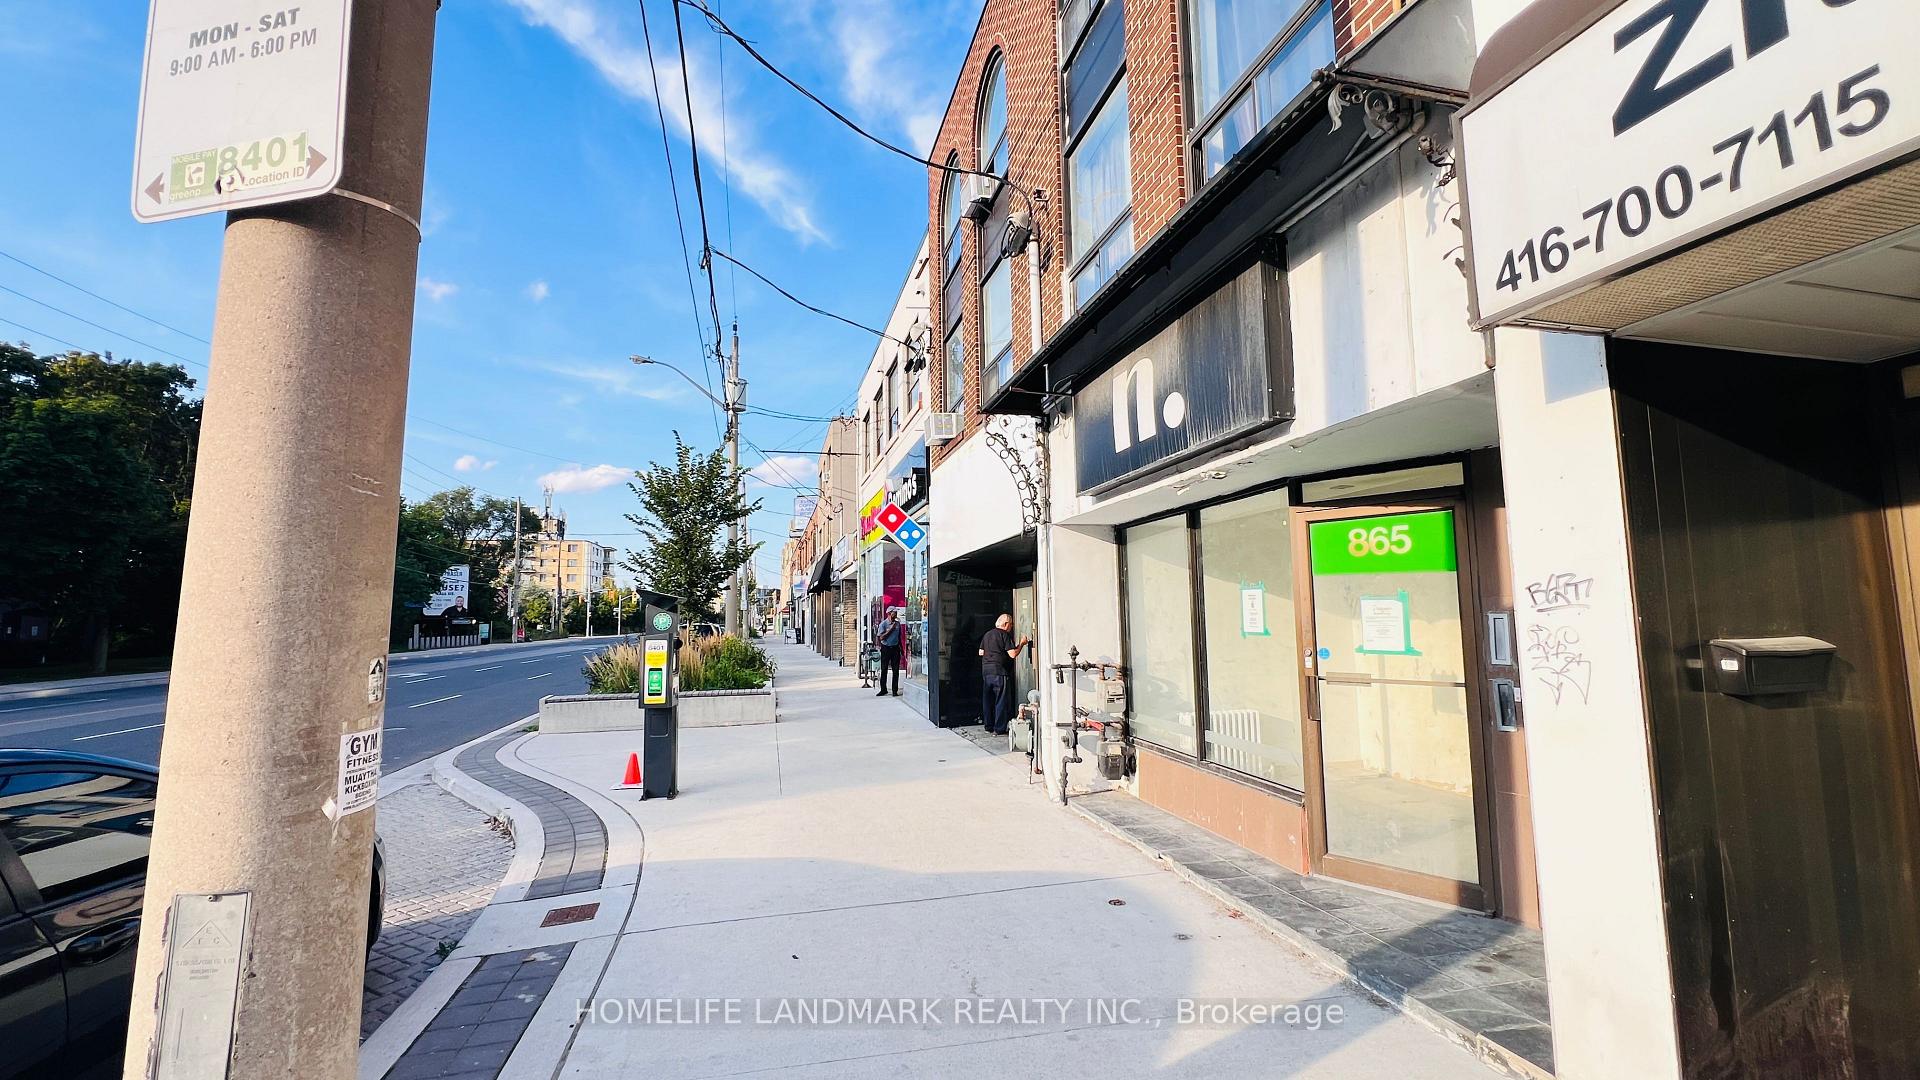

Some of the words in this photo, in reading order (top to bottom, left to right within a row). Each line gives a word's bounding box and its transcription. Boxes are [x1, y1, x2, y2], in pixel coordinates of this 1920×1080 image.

[189, 22, 239, 49] MON
[258, 7, 301, 33] SAT
[170, 54, 203, 77] 9:00
[207, 46, 236, 69] AM
[250, 35, 285, 59] 6:00
[289, 27, 318, 50] PM
[218, 131, 307, 175] 8401
[293, 165, 306, 178] ID
[1496, 64, 1890, 292] 416-700-7115
[1348, 524, 1412, 557] 865
[442, 584, 465, 592] USE?
[350, 732, 378, 755] GYM
[346, 752, 379, 769] FITNESS
